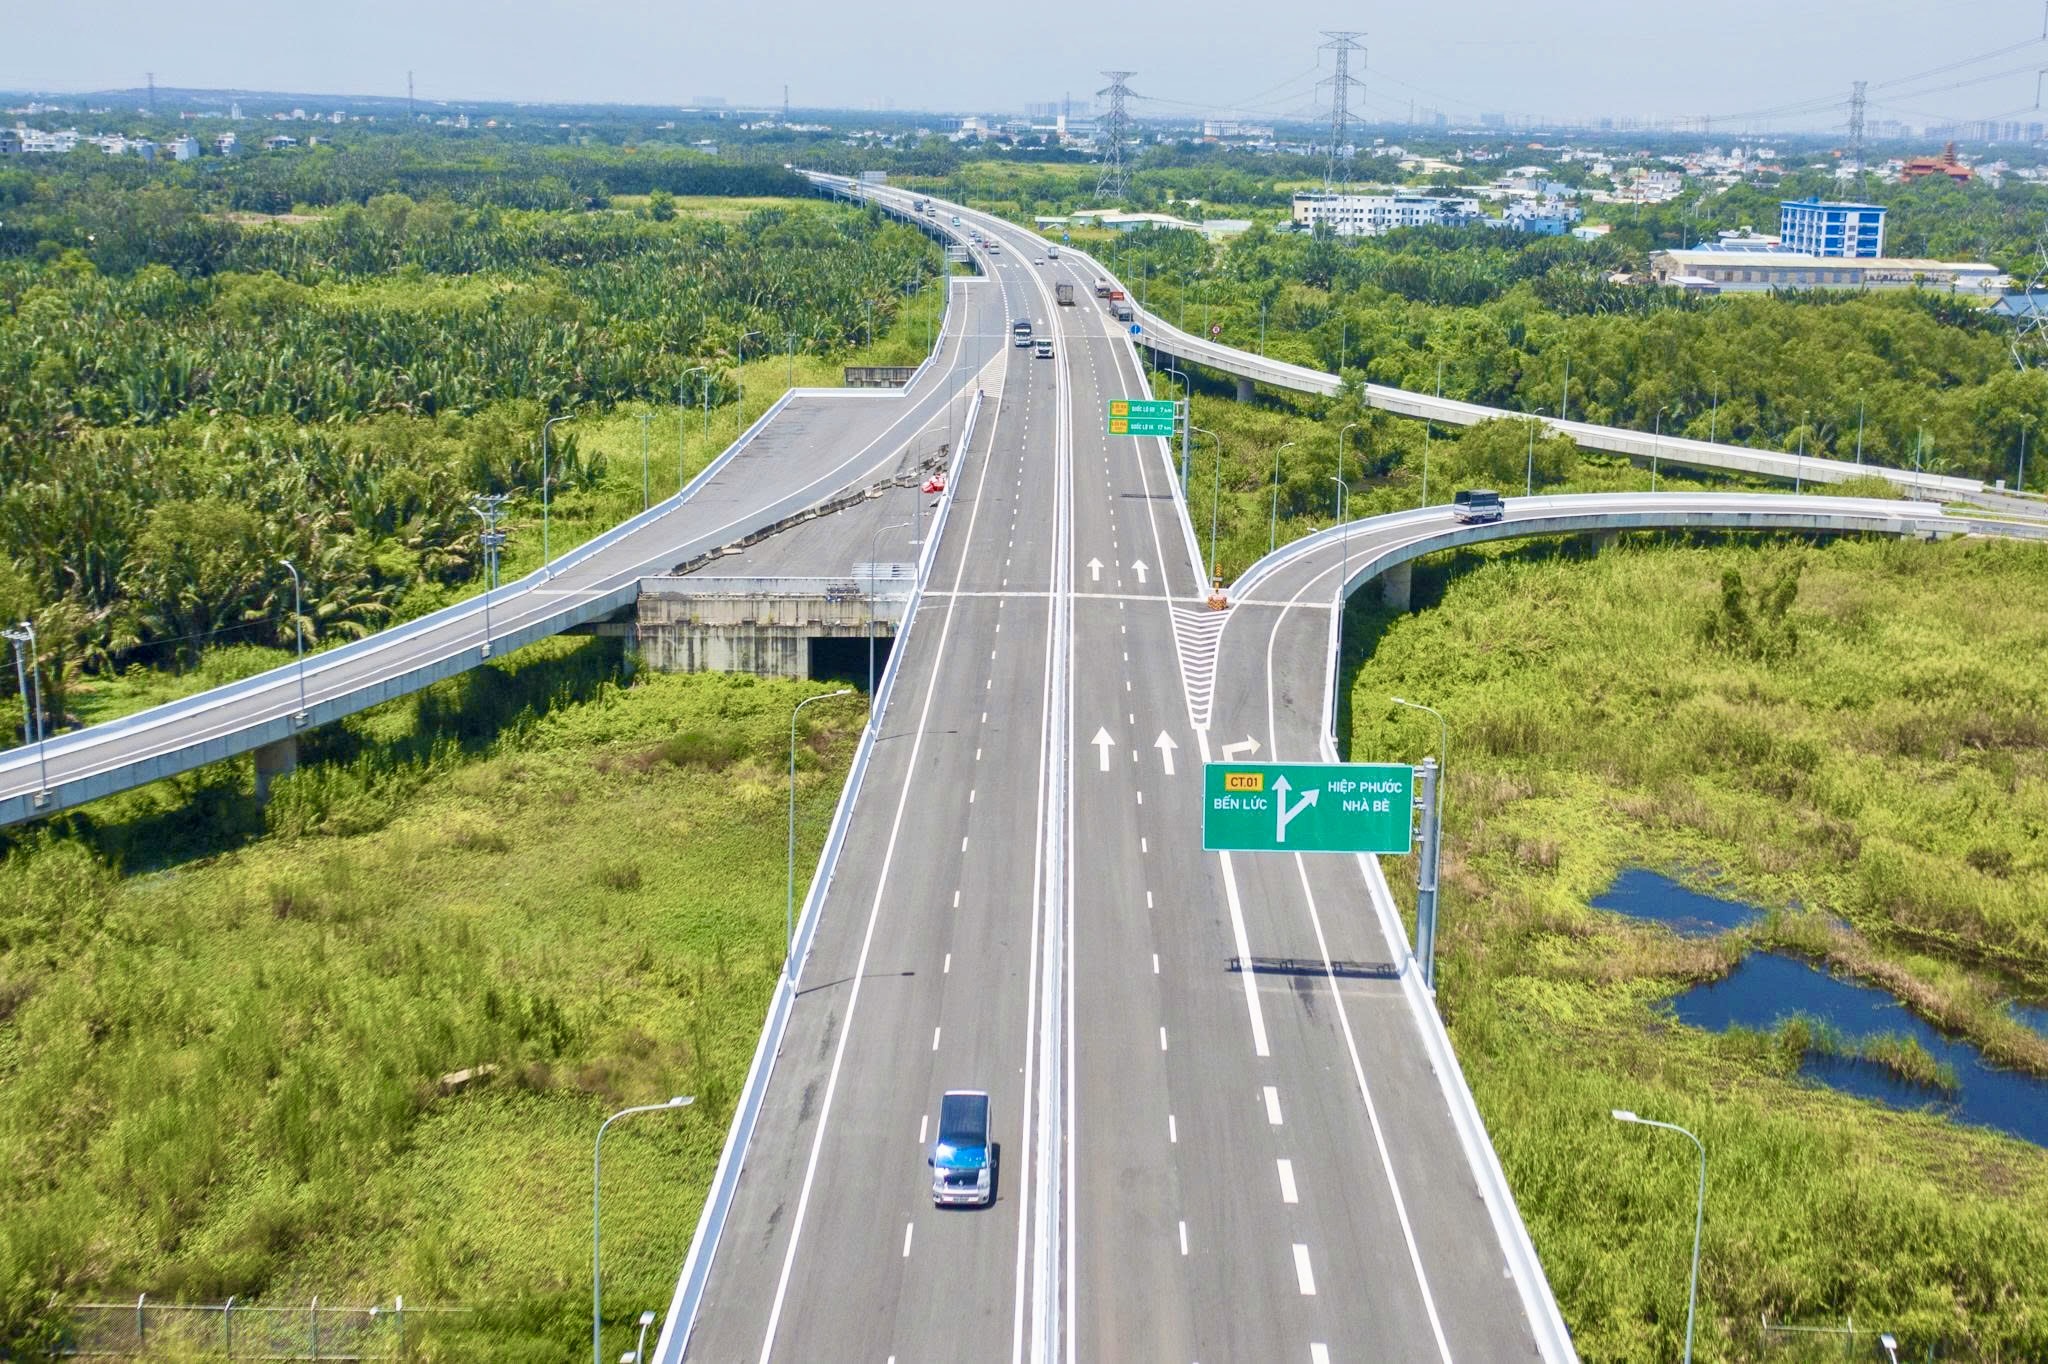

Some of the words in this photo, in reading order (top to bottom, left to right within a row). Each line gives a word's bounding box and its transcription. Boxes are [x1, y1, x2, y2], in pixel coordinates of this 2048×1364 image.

[1230, 776, 1258, 788] CT.01
[1328, 780, 1356, 794] HIỆP
[1360, 778, 1403, 793] PHƯỚC
[1214, 795, 1241, 810] BẾN
[1243, 795, 1268, 810] LỨC
[1343, 797, 1369, 812] NHÀ
[1373, 799, 1390, 812] BÈ
